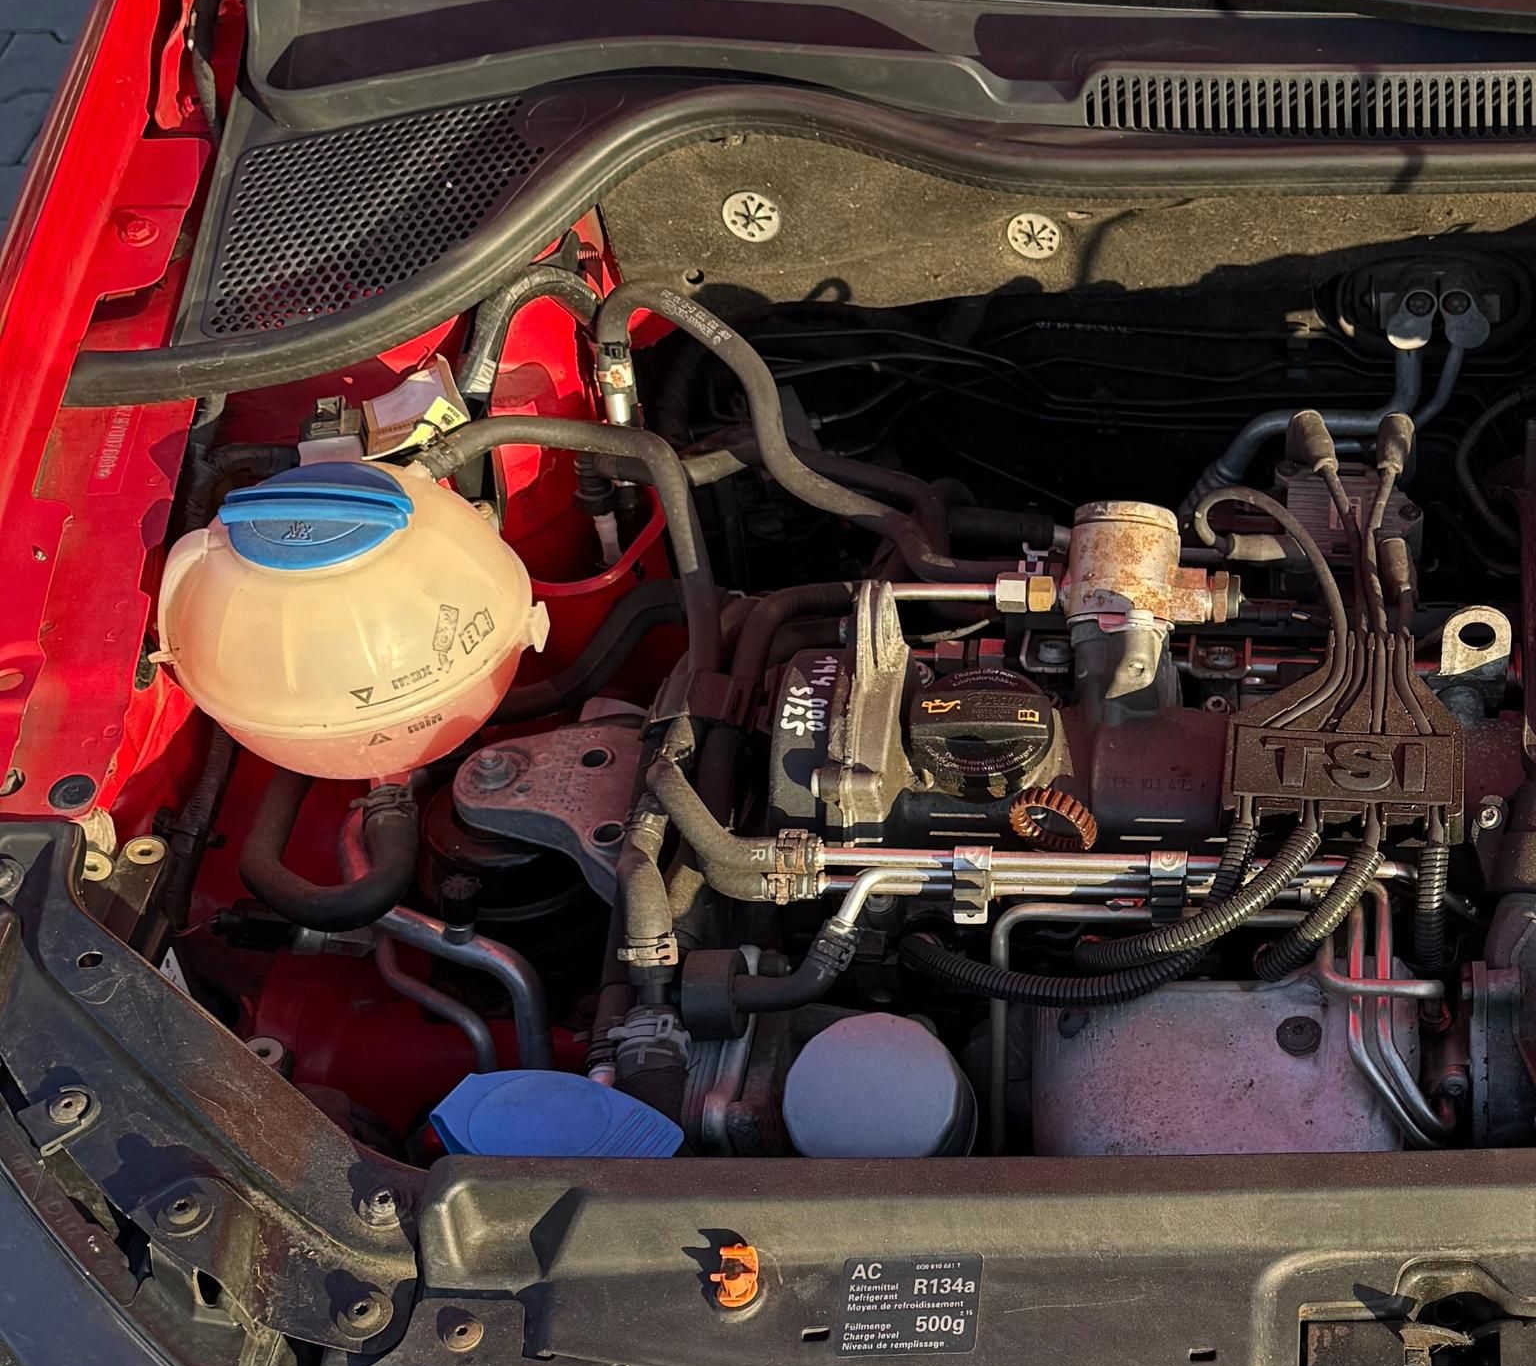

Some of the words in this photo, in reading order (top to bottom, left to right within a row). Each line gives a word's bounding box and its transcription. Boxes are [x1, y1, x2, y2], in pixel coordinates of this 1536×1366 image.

[391, 664, 434, 690] max
[407, 712, 443, 734] min
[1260, 737, 1427, 793] TSI
[851, 1263, 882, 1280] AC
[913, 1277, 976, 1295] R134a
[848, 1293, 898, 1302] Refrigerant
[880, 1302, 891, 1310] de
[893, 1301, 964, 1310] refroidissement
[844, 1322, 891, 1331] Füllmenge
[915, 1315, 965, 1335] 500g
[843, 1332, 875, 1341] Charge
[878, 1331, 899, 1339] level
[841, 1342, 873, 1351] Niveau
[876, 1341, 887, 1349] de
[890, 1340, 945, 1350] remplissage
